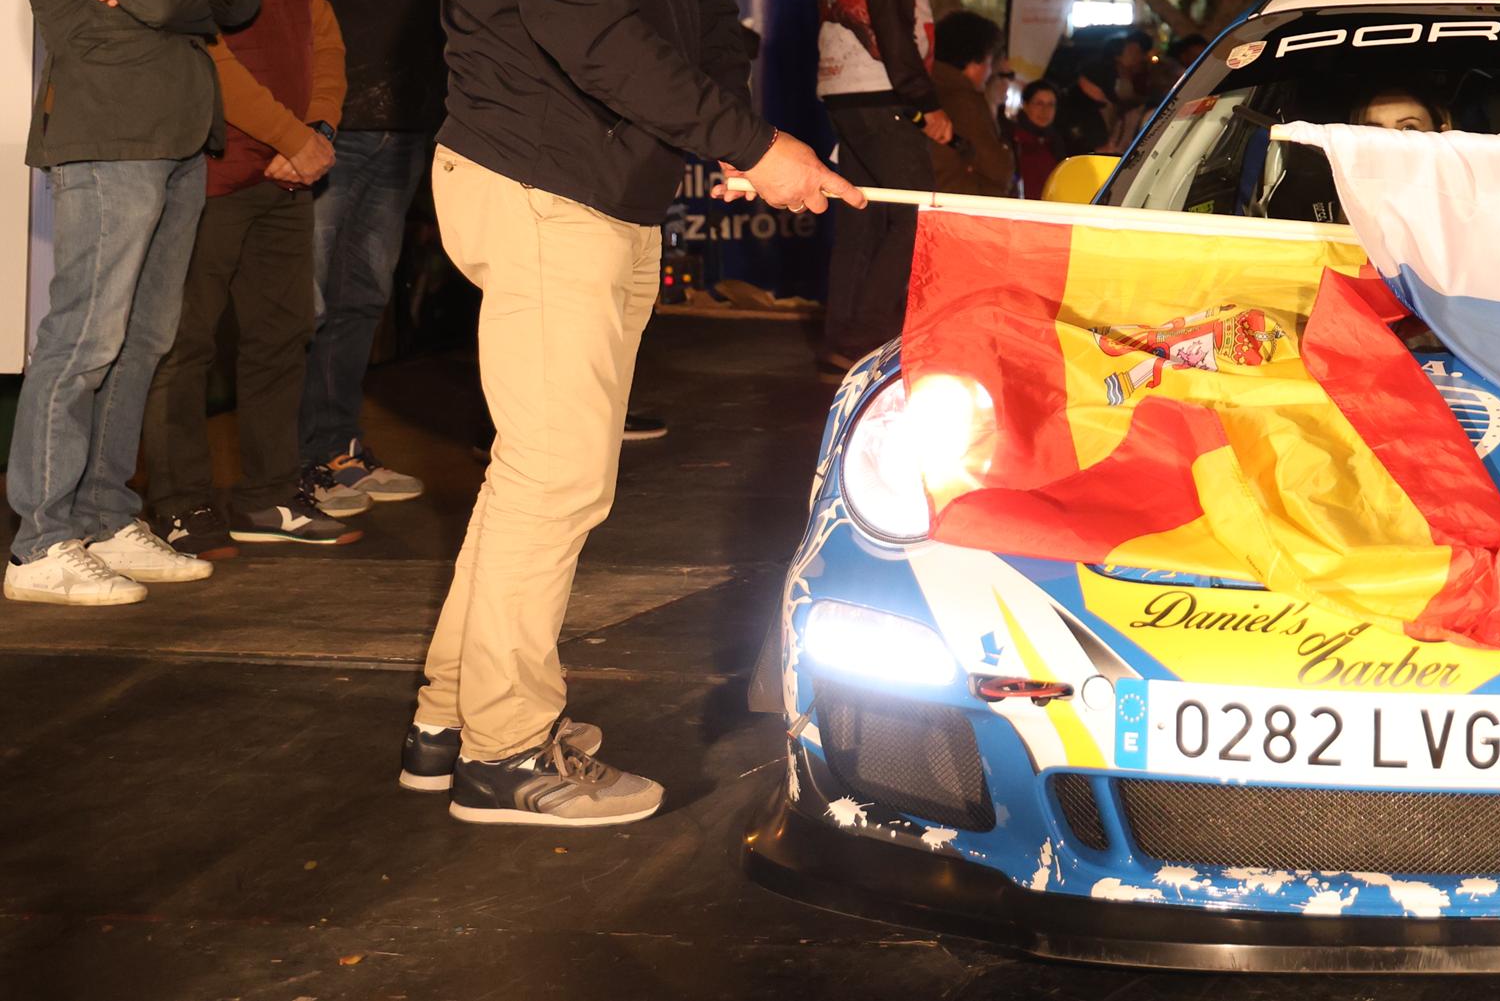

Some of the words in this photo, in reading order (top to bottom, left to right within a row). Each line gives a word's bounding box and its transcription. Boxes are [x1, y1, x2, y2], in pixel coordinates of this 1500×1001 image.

[1129, 590, 1310, 637] Daniel's
[1296, 621, 1463, 690] Barber
[1123, 732, 1139, 753] E
[1175, 698, 1344, 767] 0282
[1373, 706, 1500, 770] LVG
